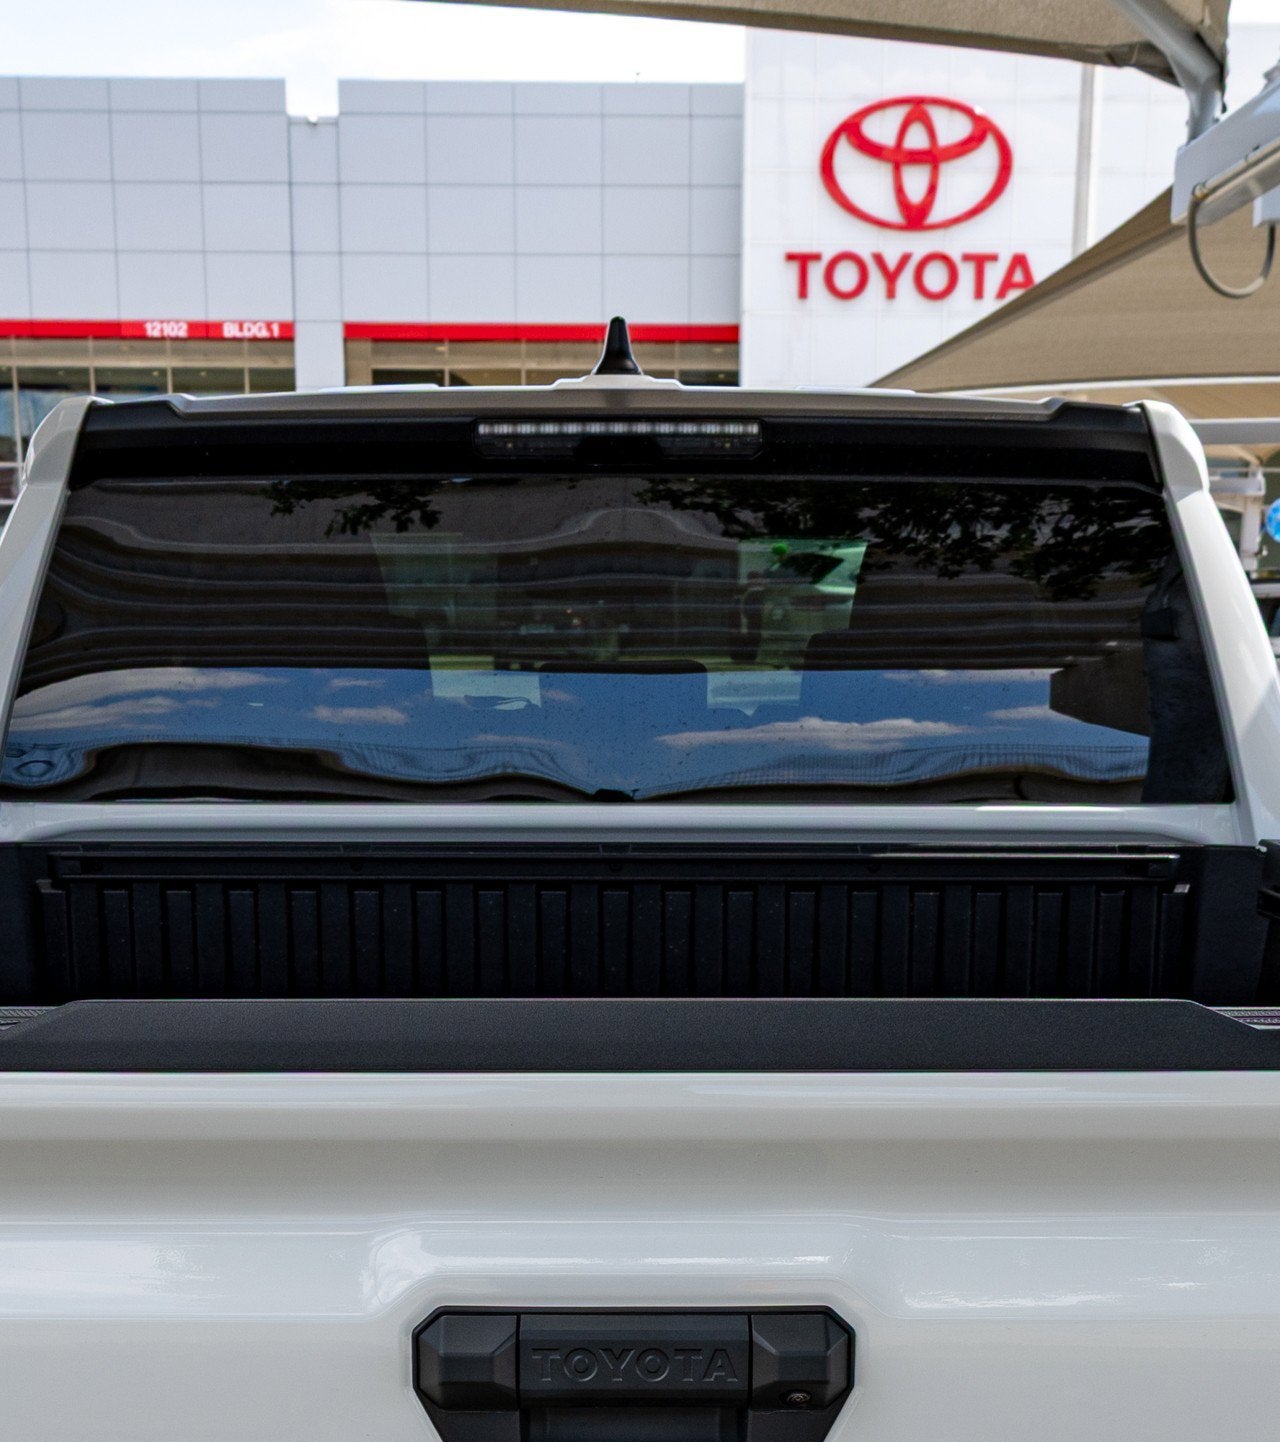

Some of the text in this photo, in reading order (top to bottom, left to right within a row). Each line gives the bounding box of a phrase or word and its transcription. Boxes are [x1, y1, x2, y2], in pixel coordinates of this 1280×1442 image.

[785, 250, 1036, 300] TOYOTA
[145, 321, 188, 338] 12102
[531, 1347, 738, 1383] TOYOTA
